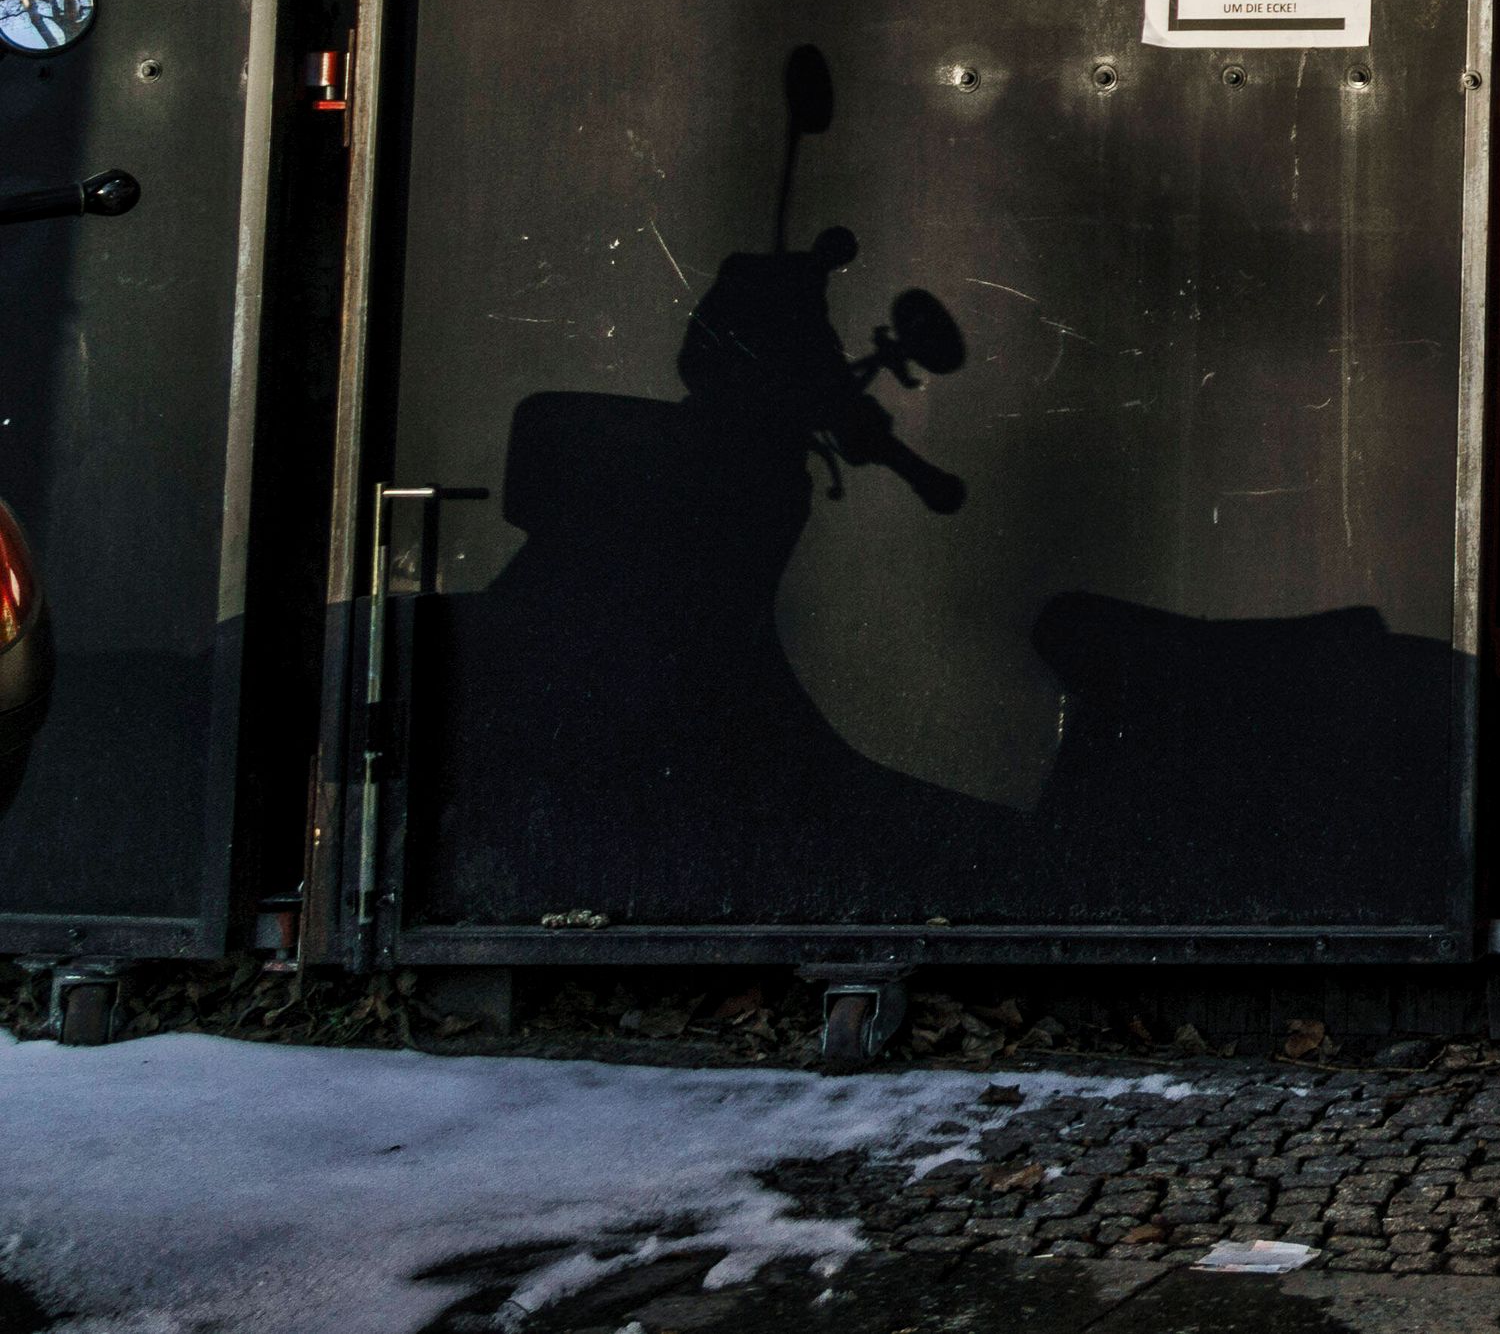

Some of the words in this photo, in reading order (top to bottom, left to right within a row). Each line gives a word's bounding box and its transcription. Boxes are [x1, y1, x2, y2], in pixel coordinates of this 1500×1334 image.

[1223, 3, 1243, 14] UM
[1246, 3, 1264, 14] DIE
[1266, 3, 1298, 14] ECKE!
